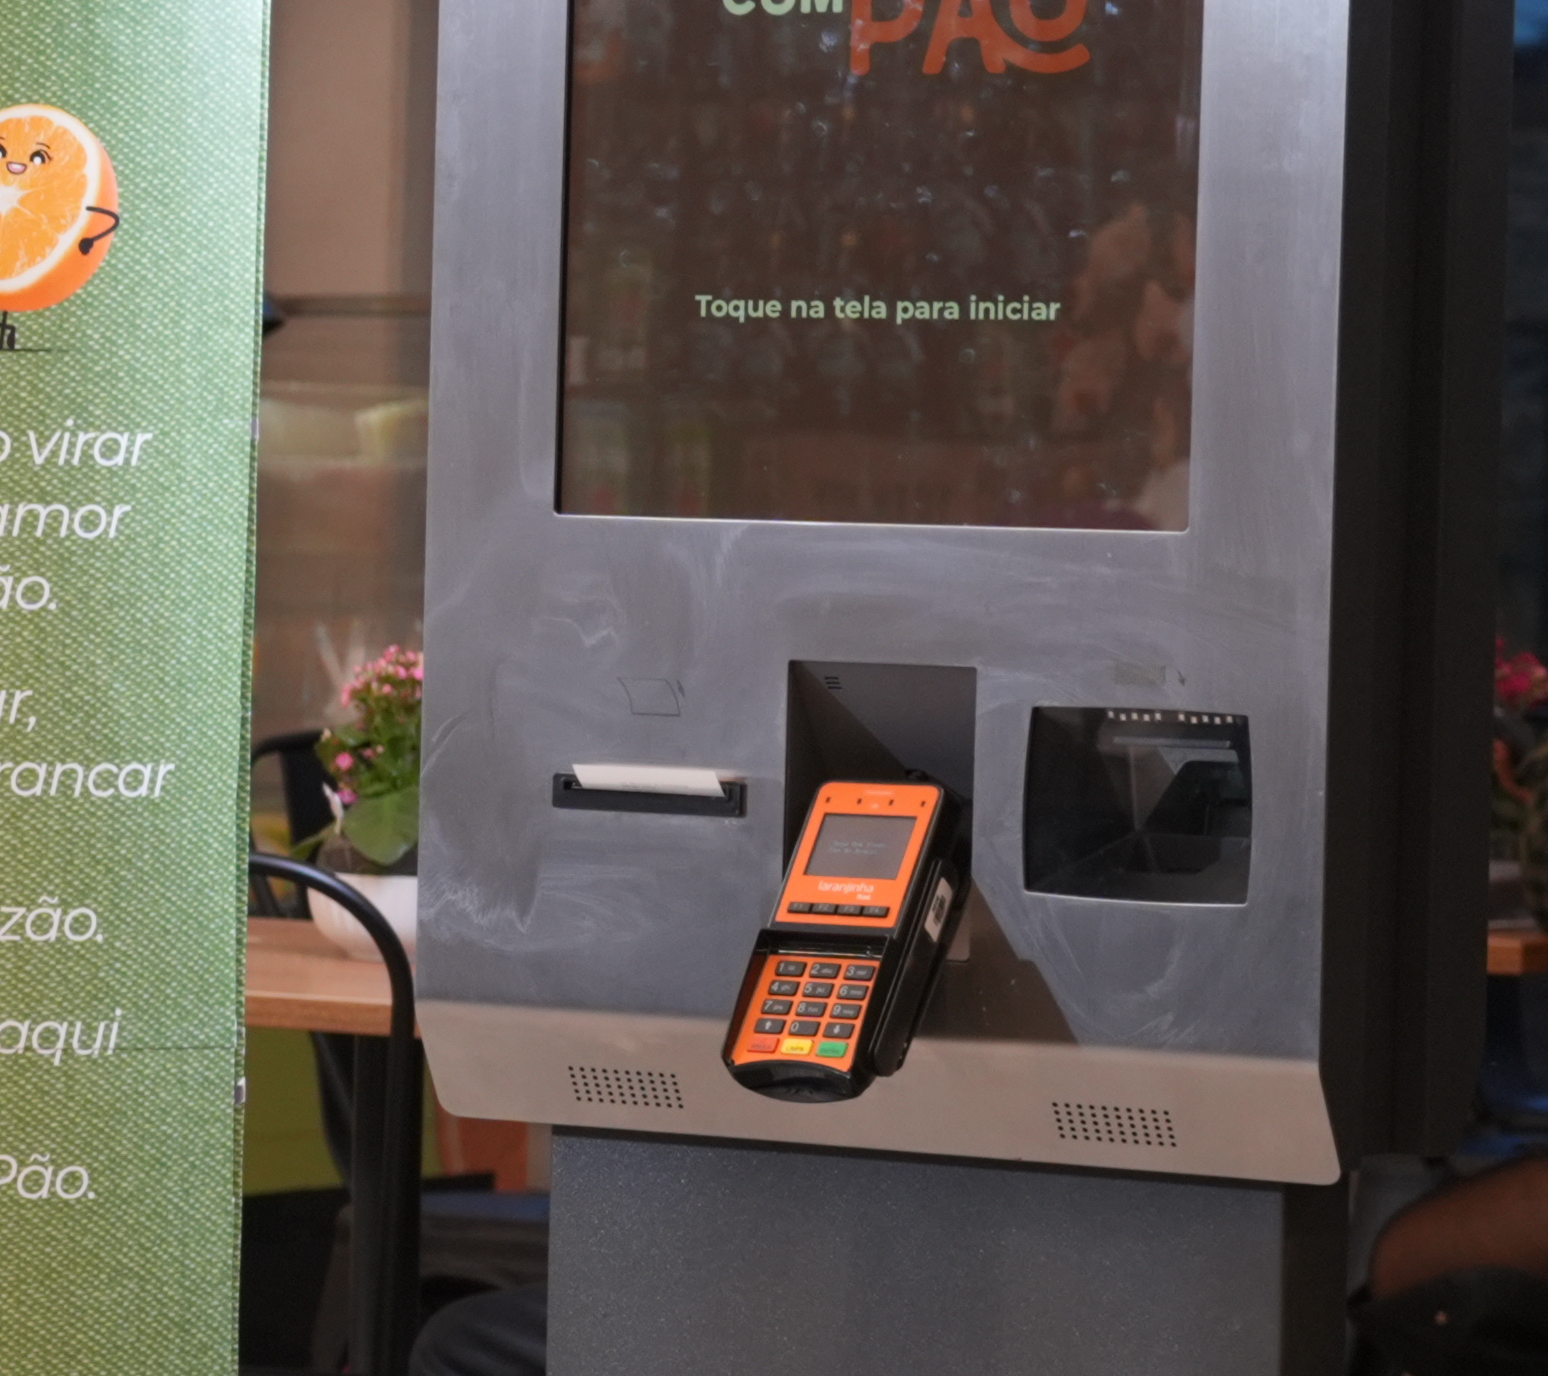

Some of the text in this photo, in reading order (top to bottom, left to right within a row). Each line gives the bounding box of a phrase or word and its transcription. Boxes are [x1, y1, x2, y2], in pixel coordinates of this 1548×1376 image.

[695, 294, 1061, 326] Toque na tela para iniciar
[25, 419, 153, 467] virar
[817, 881, 874, 894] laranjinha
